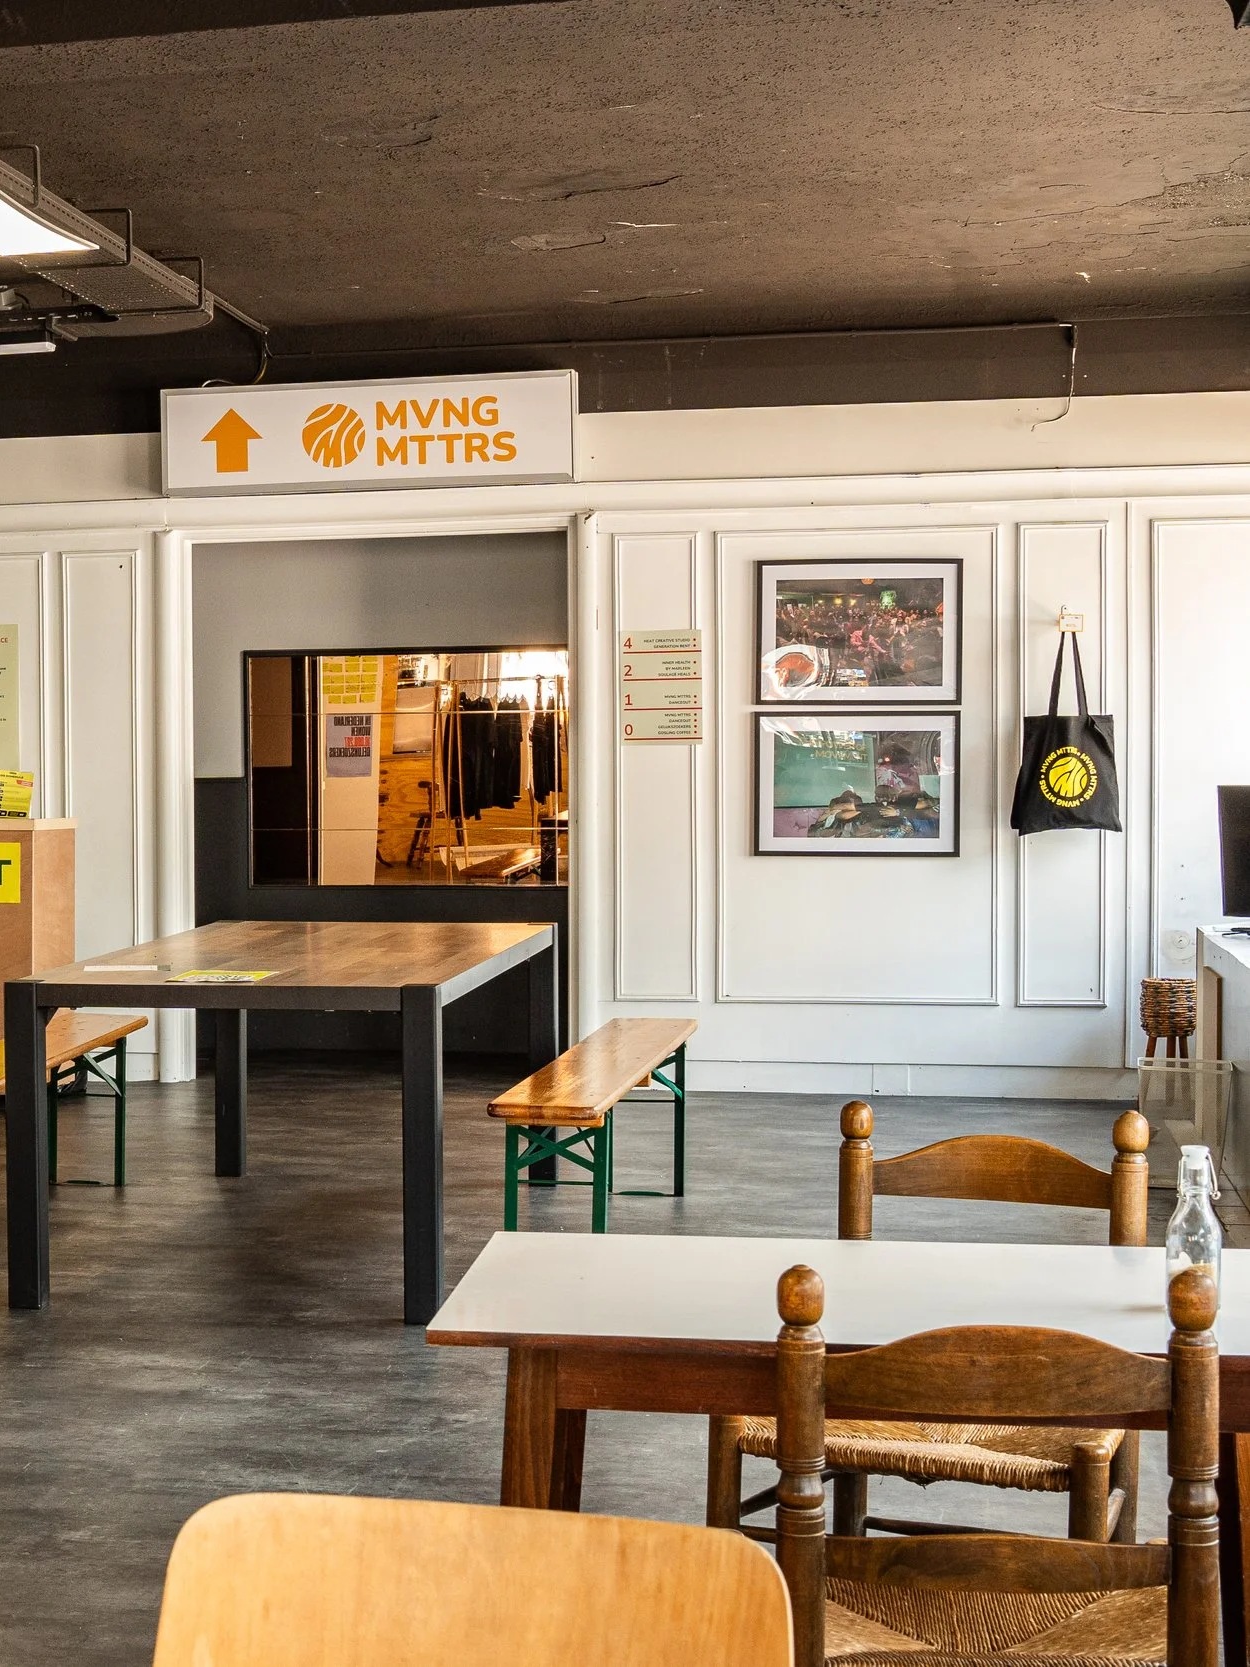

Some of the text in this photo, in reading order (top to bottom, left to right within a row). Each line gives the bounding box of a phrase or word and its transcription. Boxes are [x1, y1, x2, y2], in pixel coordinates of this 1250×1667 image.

[376, 395, 499, 430] MVNG
[376, 432, 517, 466] MTTRS
[624, 637, 632, 649] 4
[624, 665, 632, 676] 2
[625, 694, 632, 705] 1
[625, 724, 633, 735] 0
[1040, 752, 1057, 772] MVNG
[1080, 753, 1096, 774] MVNG
[1056, 799, 1080, 807] MVNG
